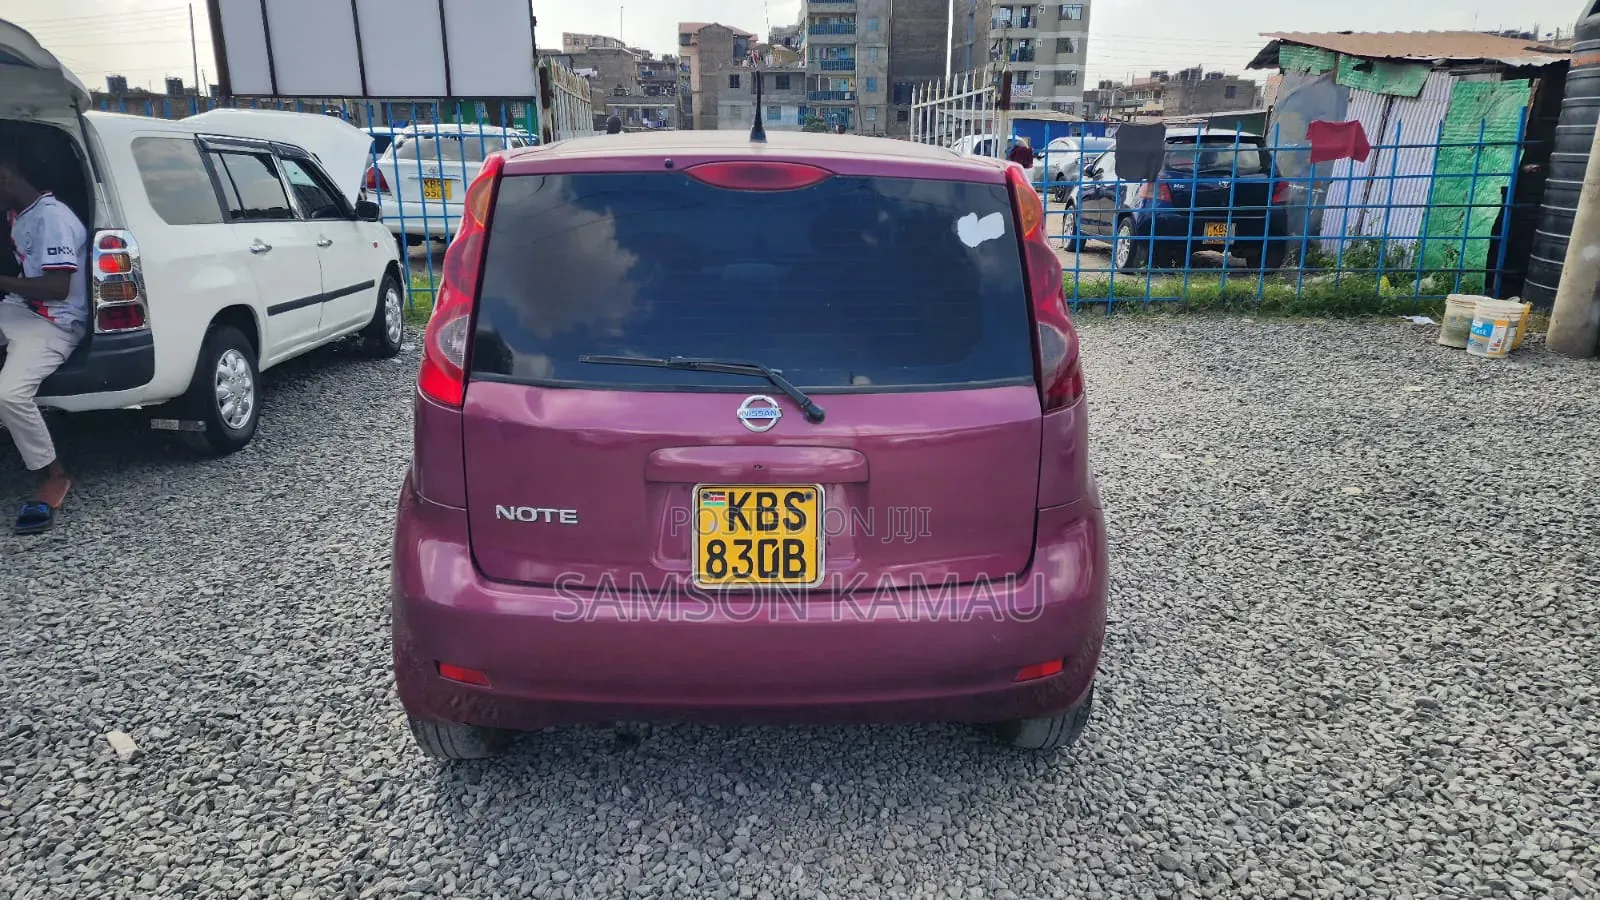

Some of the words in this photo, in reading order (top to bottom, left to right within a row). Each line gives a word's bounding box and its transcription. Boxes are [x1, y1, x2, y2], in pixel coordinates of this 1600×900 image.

[495, 504, 579, 524] NOTE
[728, 491, 807, 532] KBS
[706, 539, 807, 580] 830B
